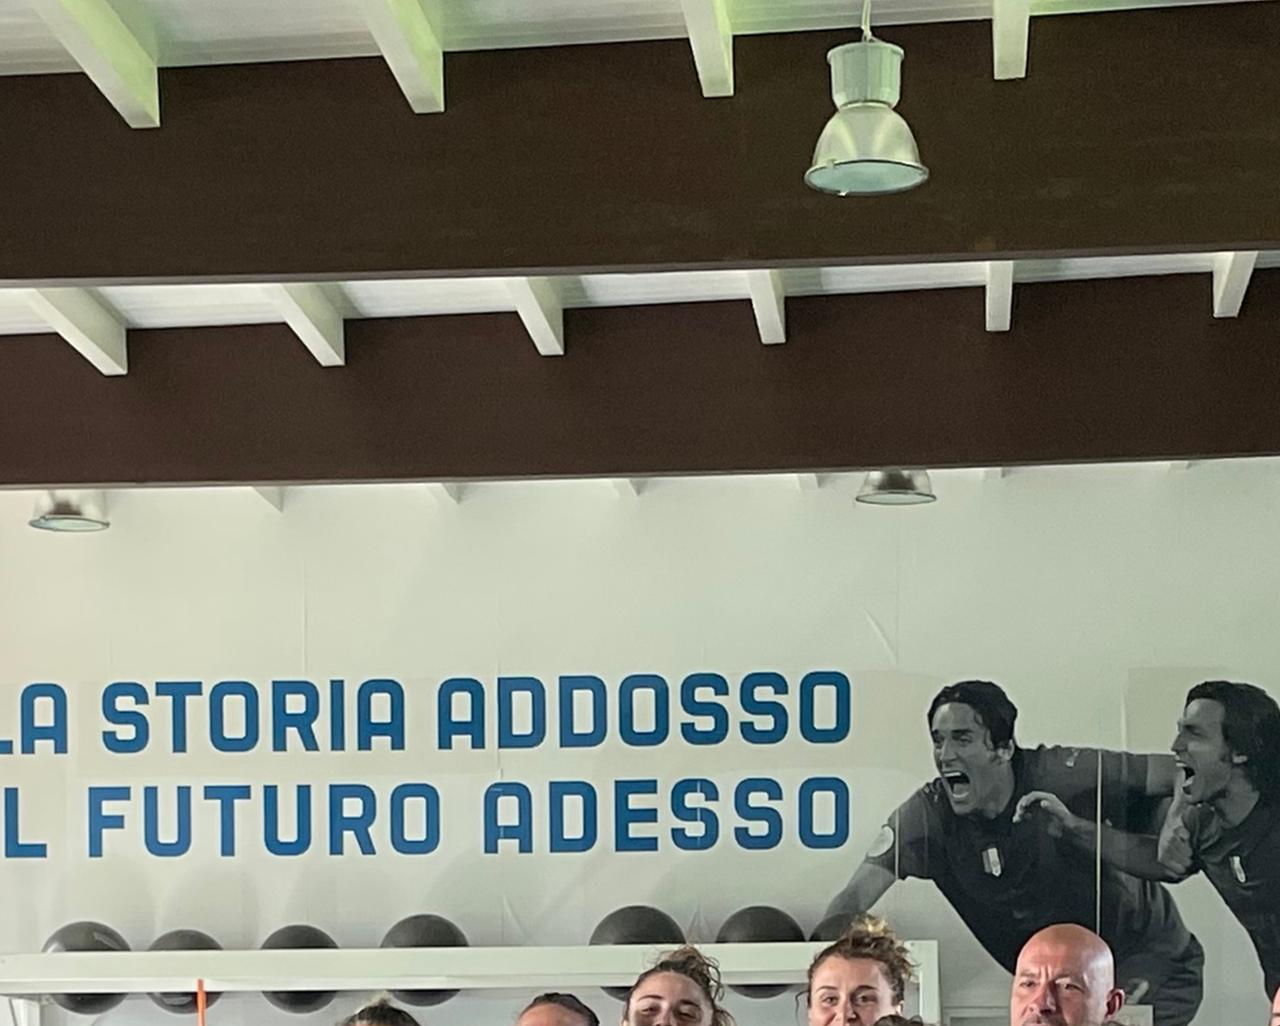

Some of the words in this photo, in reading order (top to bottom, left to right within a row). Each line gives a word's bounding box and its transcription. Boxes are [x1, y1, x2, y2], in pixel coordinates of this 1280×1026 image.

[102, 679, 404, 753] STORIA
[437, 671, 850, 748] ADDOSSO
[88, 783, 439, 857] FUTURO
[483, 776, 849, 853] ADESSO
